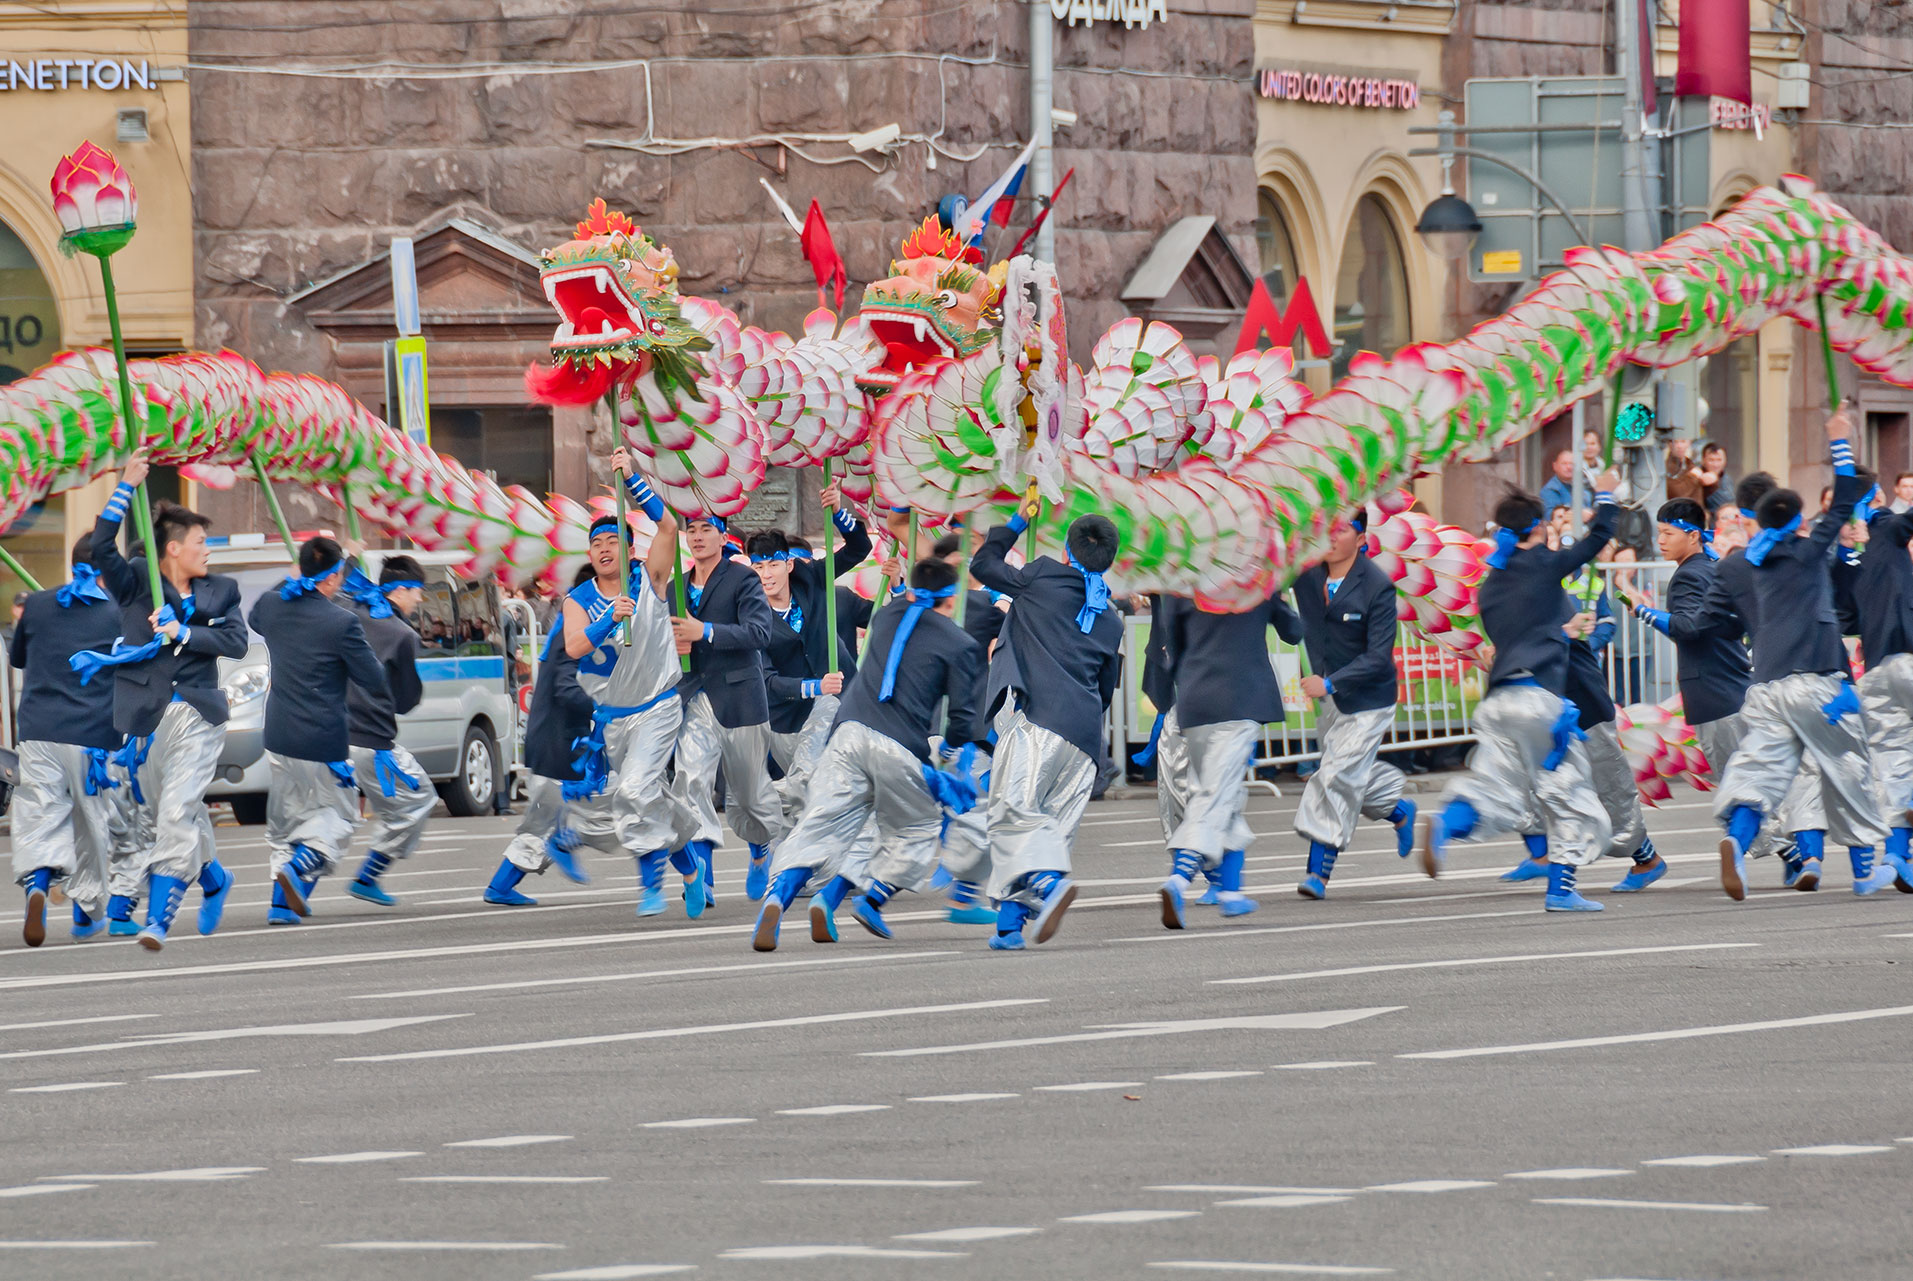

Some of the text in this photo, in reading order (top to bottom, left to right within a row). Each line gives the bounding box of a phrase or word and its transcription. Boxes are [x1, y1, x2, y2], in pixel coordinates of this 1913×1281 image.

[1261, 70, 1418, 109] UNITED COLORS OF BENETTON
